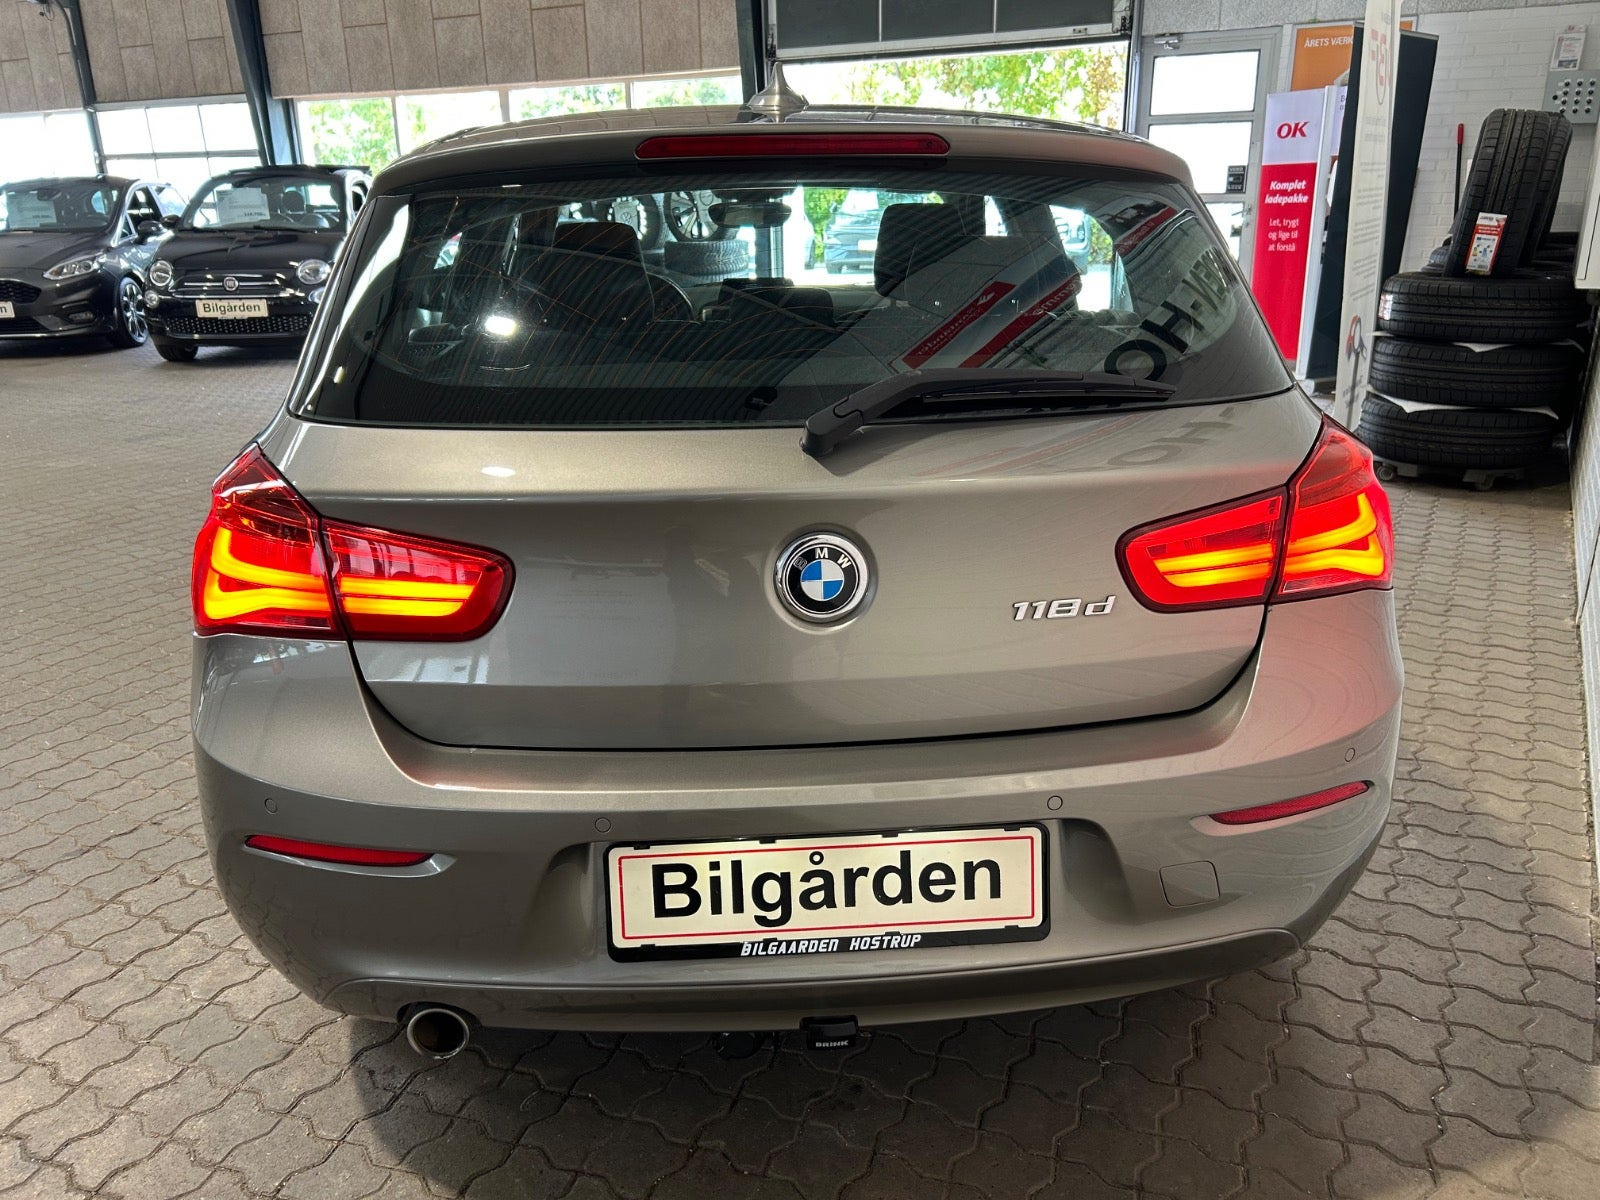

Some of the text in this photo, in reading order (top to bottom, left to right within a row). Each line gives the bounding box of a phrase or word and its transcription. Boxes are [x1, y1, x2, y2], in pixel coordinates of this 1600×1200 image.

[1304, 37, 1329, 48] ÅRETS
[1276, 121, 1309, 139] OK
[1270, 179, 1306, 192] Komplet
[1264, 192, 1309, 206] ladepakke
[1269, 218, 1300, 229] Let, trygt
[1268, 229, 1299, 241] og lige til
[1268, 242, 1296, 252] at forstå
[202, 302, 261, 315] Bilgården
[793, 548, 851, 571] BMW
[1013, 595, 1117, 621] 118d
[651, 850, 1001, 928] Bilgården
[740, 933, 922, 957] BILGAARDEN HOSTRUP
